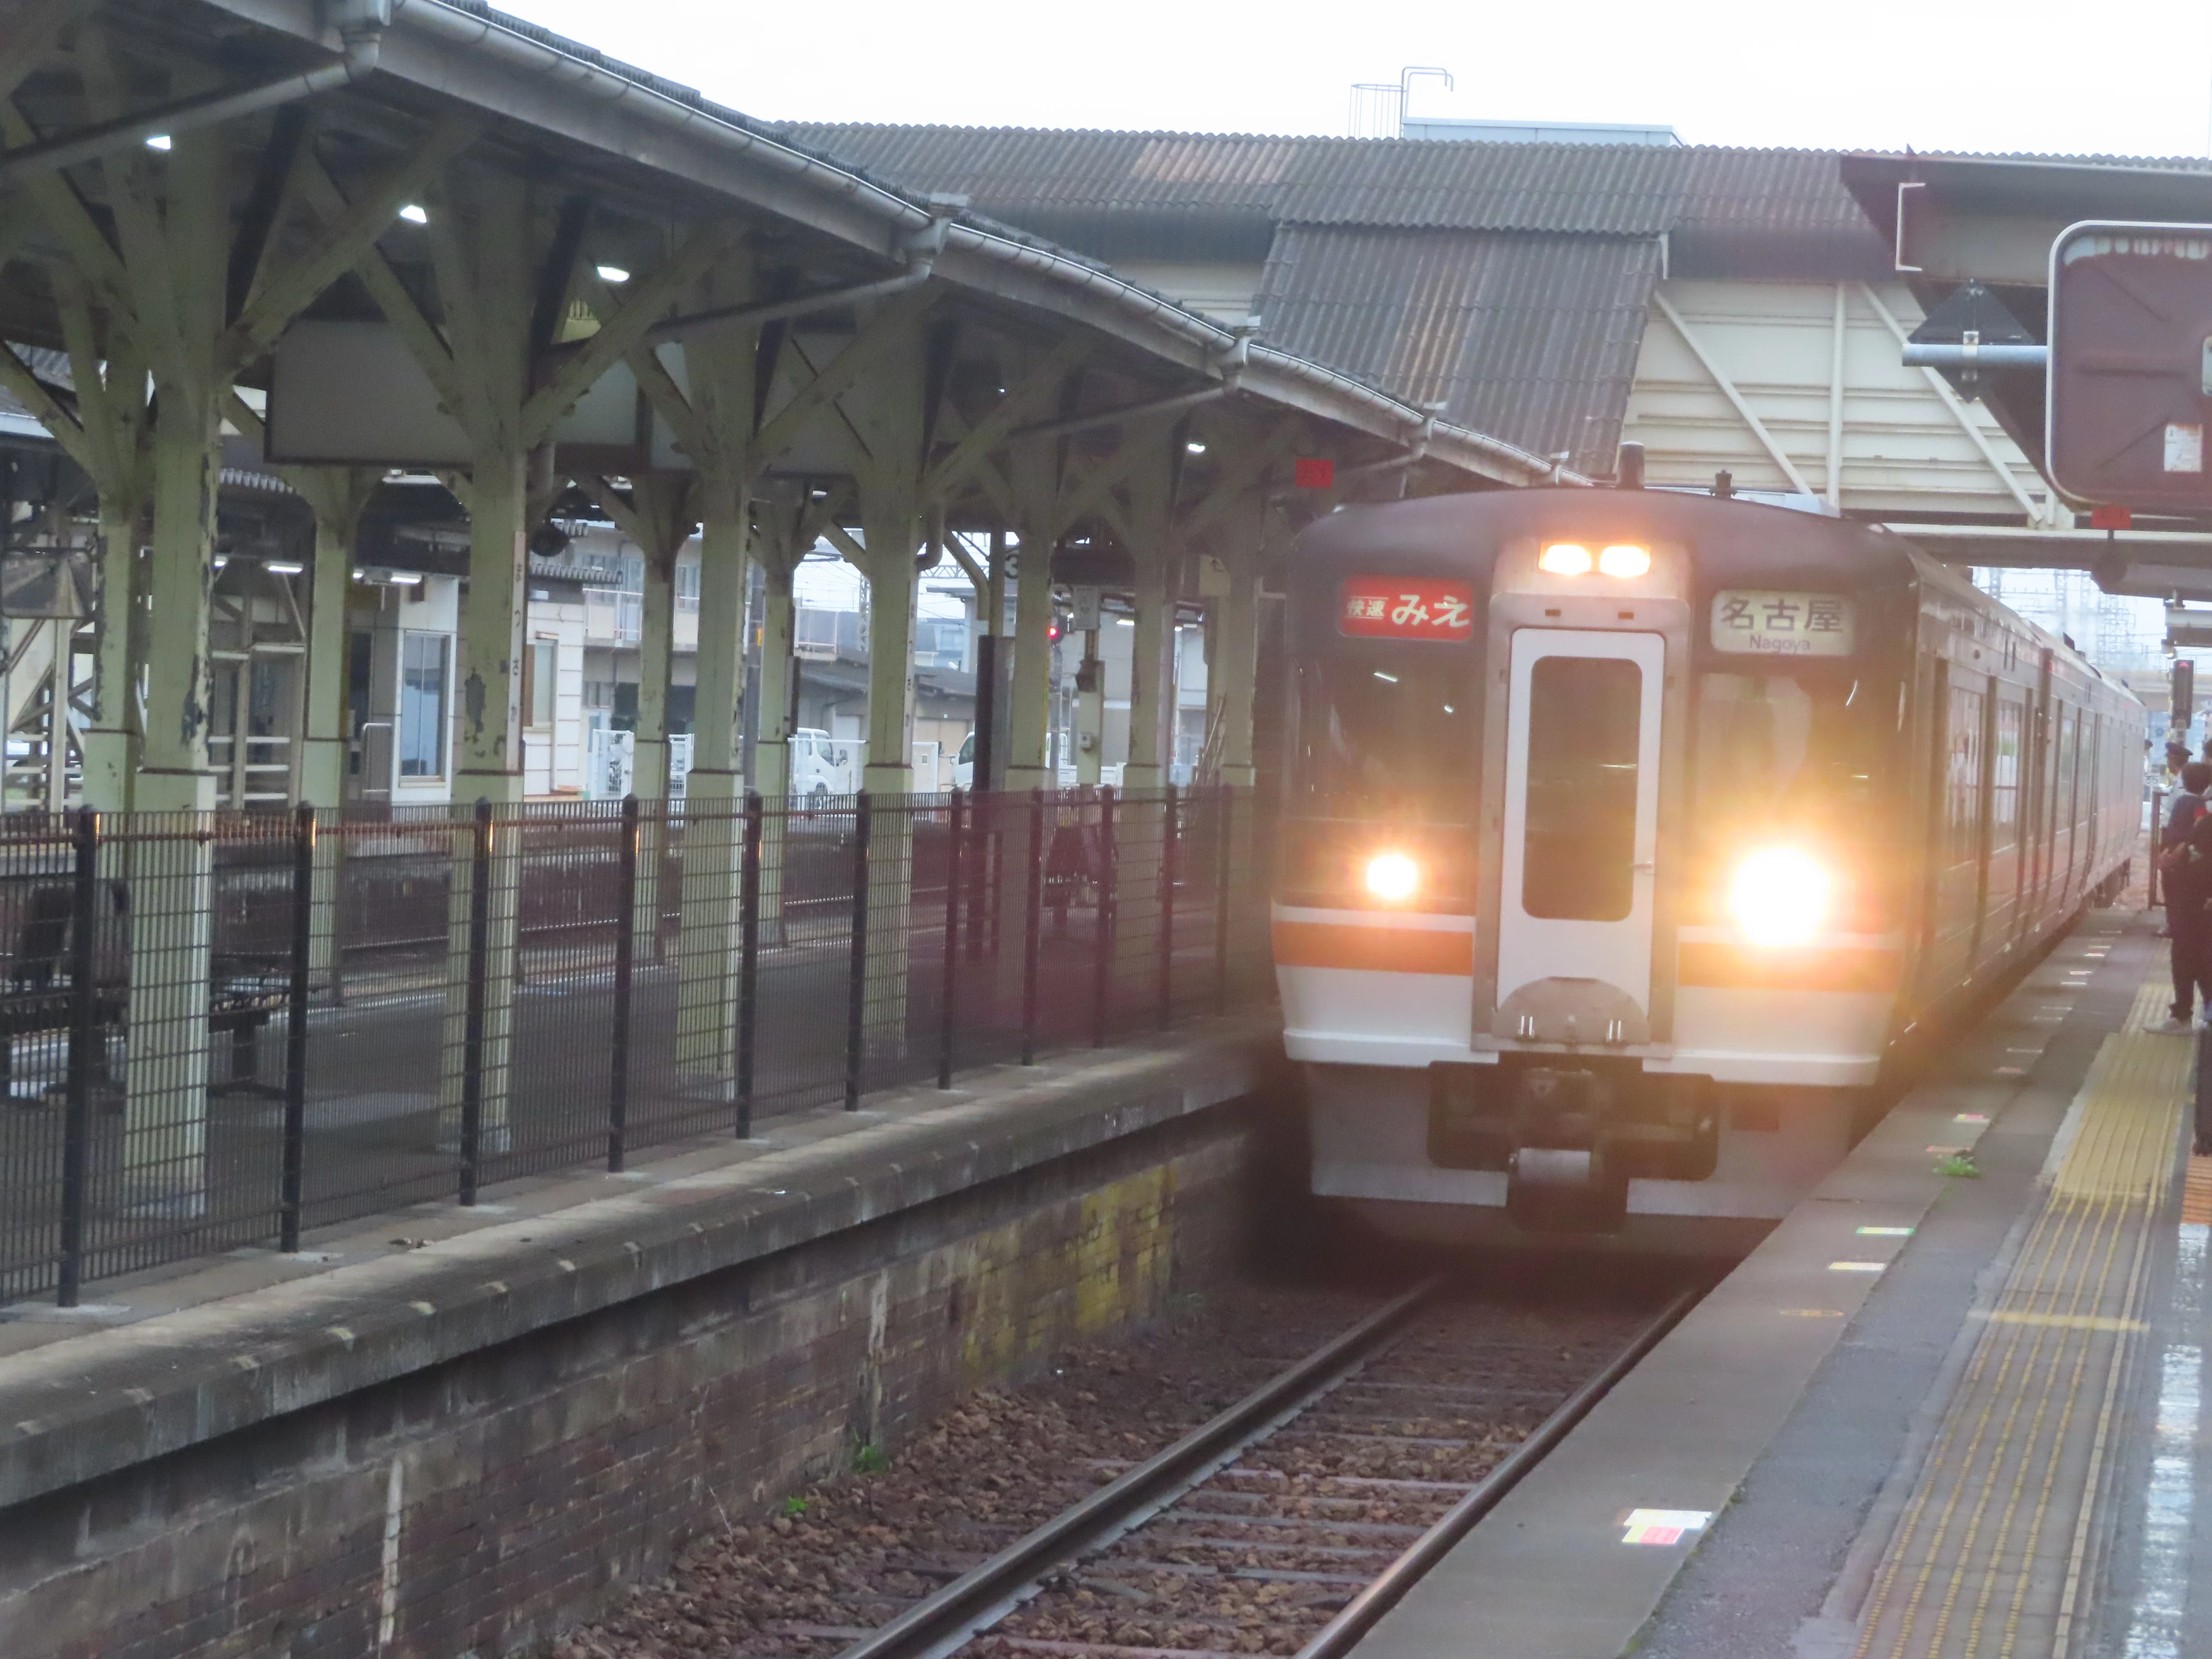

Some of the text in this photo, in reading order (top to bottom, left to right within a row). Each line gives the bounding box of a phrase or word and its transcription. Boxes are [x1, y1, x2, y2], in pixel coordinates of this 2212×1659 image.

[1347, 594, 1470, 627] 快速 みえ
[1721, 597, 1843, 632] 名古屋
[1750, 634, 1810, 655] Nagoya
[2145, 775, 2159, 784] 35
